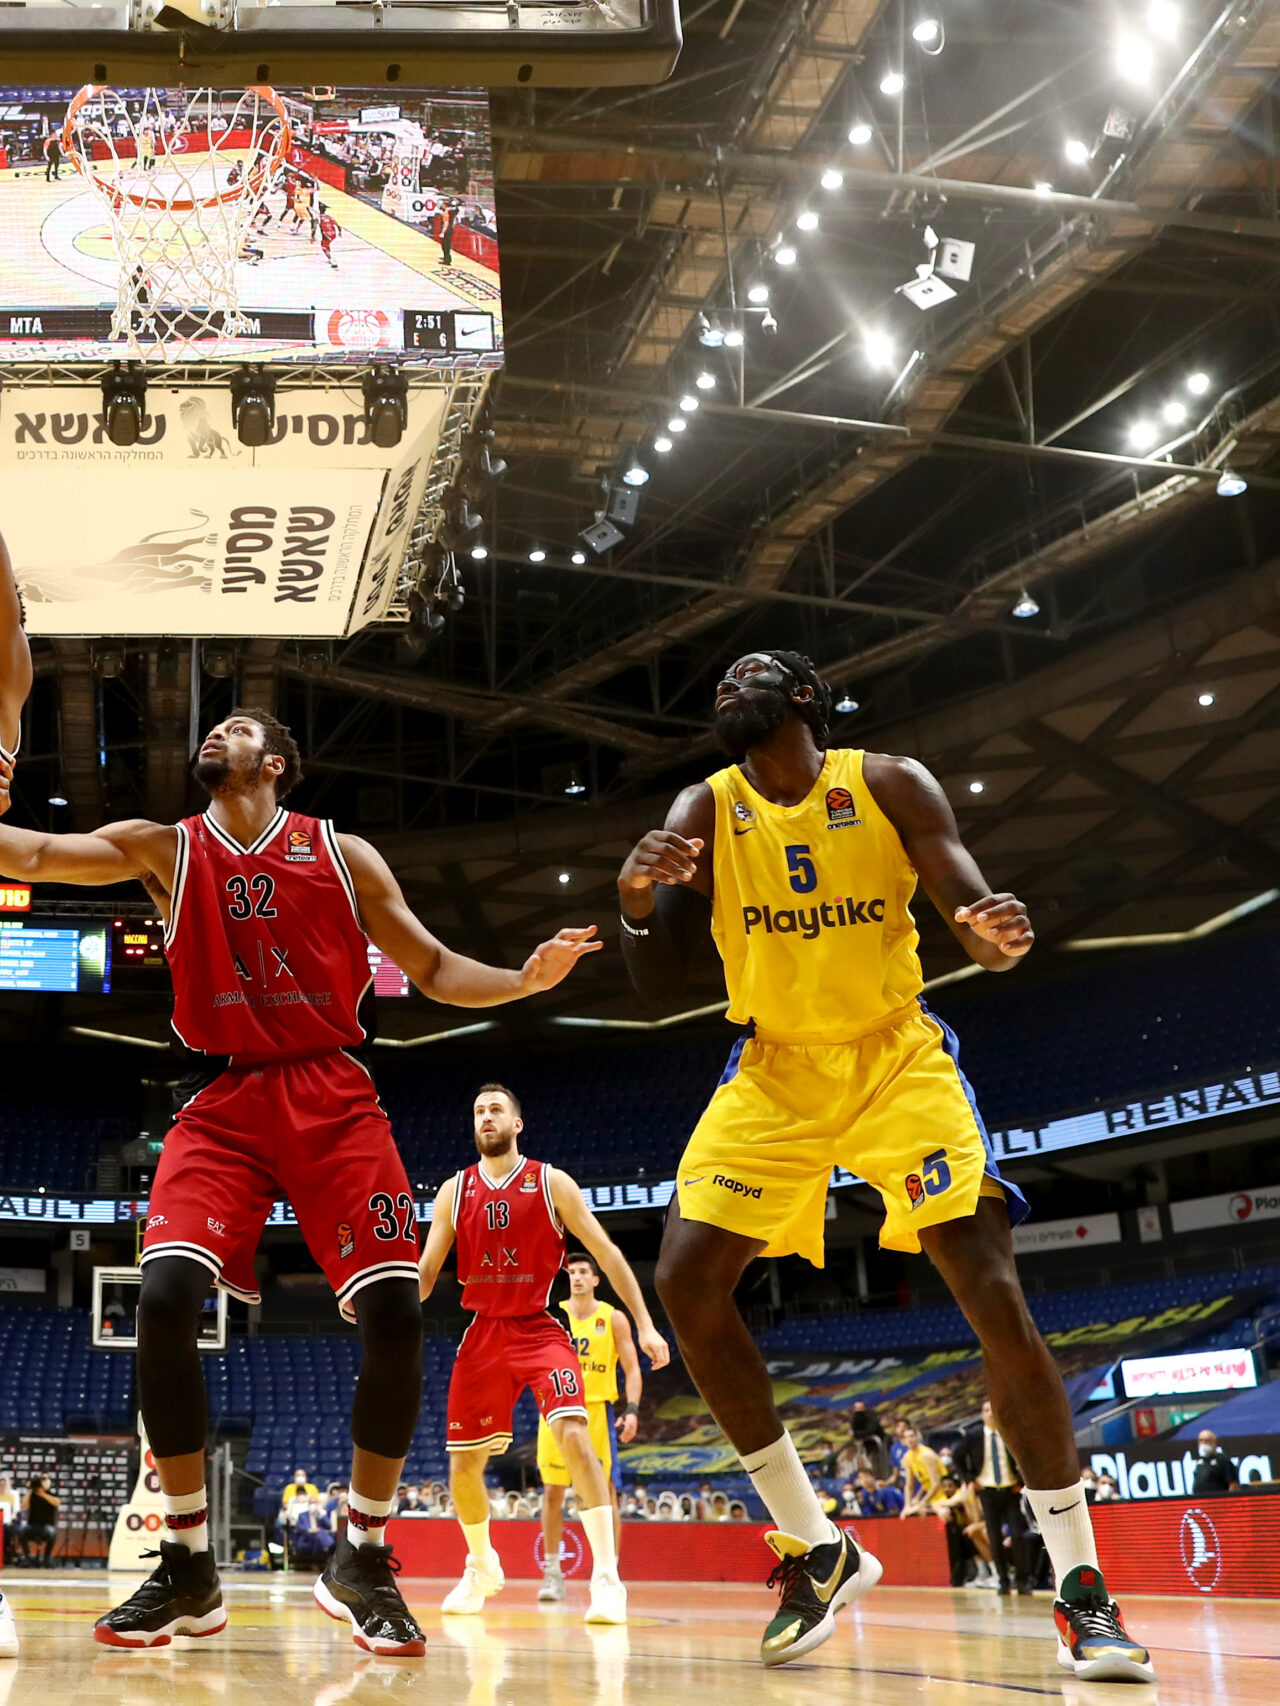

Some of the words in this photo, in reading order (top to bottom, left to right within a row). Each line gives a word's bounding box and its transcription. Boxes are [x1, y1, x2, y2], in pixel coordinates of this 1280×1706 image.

[9, 317, 43, 334] MTA
[415, 315, 442, 329] 2:51
[439, 332, 447, 347] 6
[254, 413, 375, 447] מסיע
[17, 449, 58, 461] בדרכים
[61, 450, 111, 461] הראשונה
[115, 450, 164, 463] המחלקה
[221, 505, 278, 594] מסיעי
[274, 505, 336, 604] שאשא
[785, 844, 818, 894] 5
[226, 873, 278, 921] 32
[712, 1173, 763, 1200] Rapyd
[923, 1148, 952, 1196] 5
[369, 1192, 417, 1244] 32
[484, 1200, 510, 1230] 13
[75, 1234, 85, 1247] 5
[548, 1367, 580, 1398] 13
